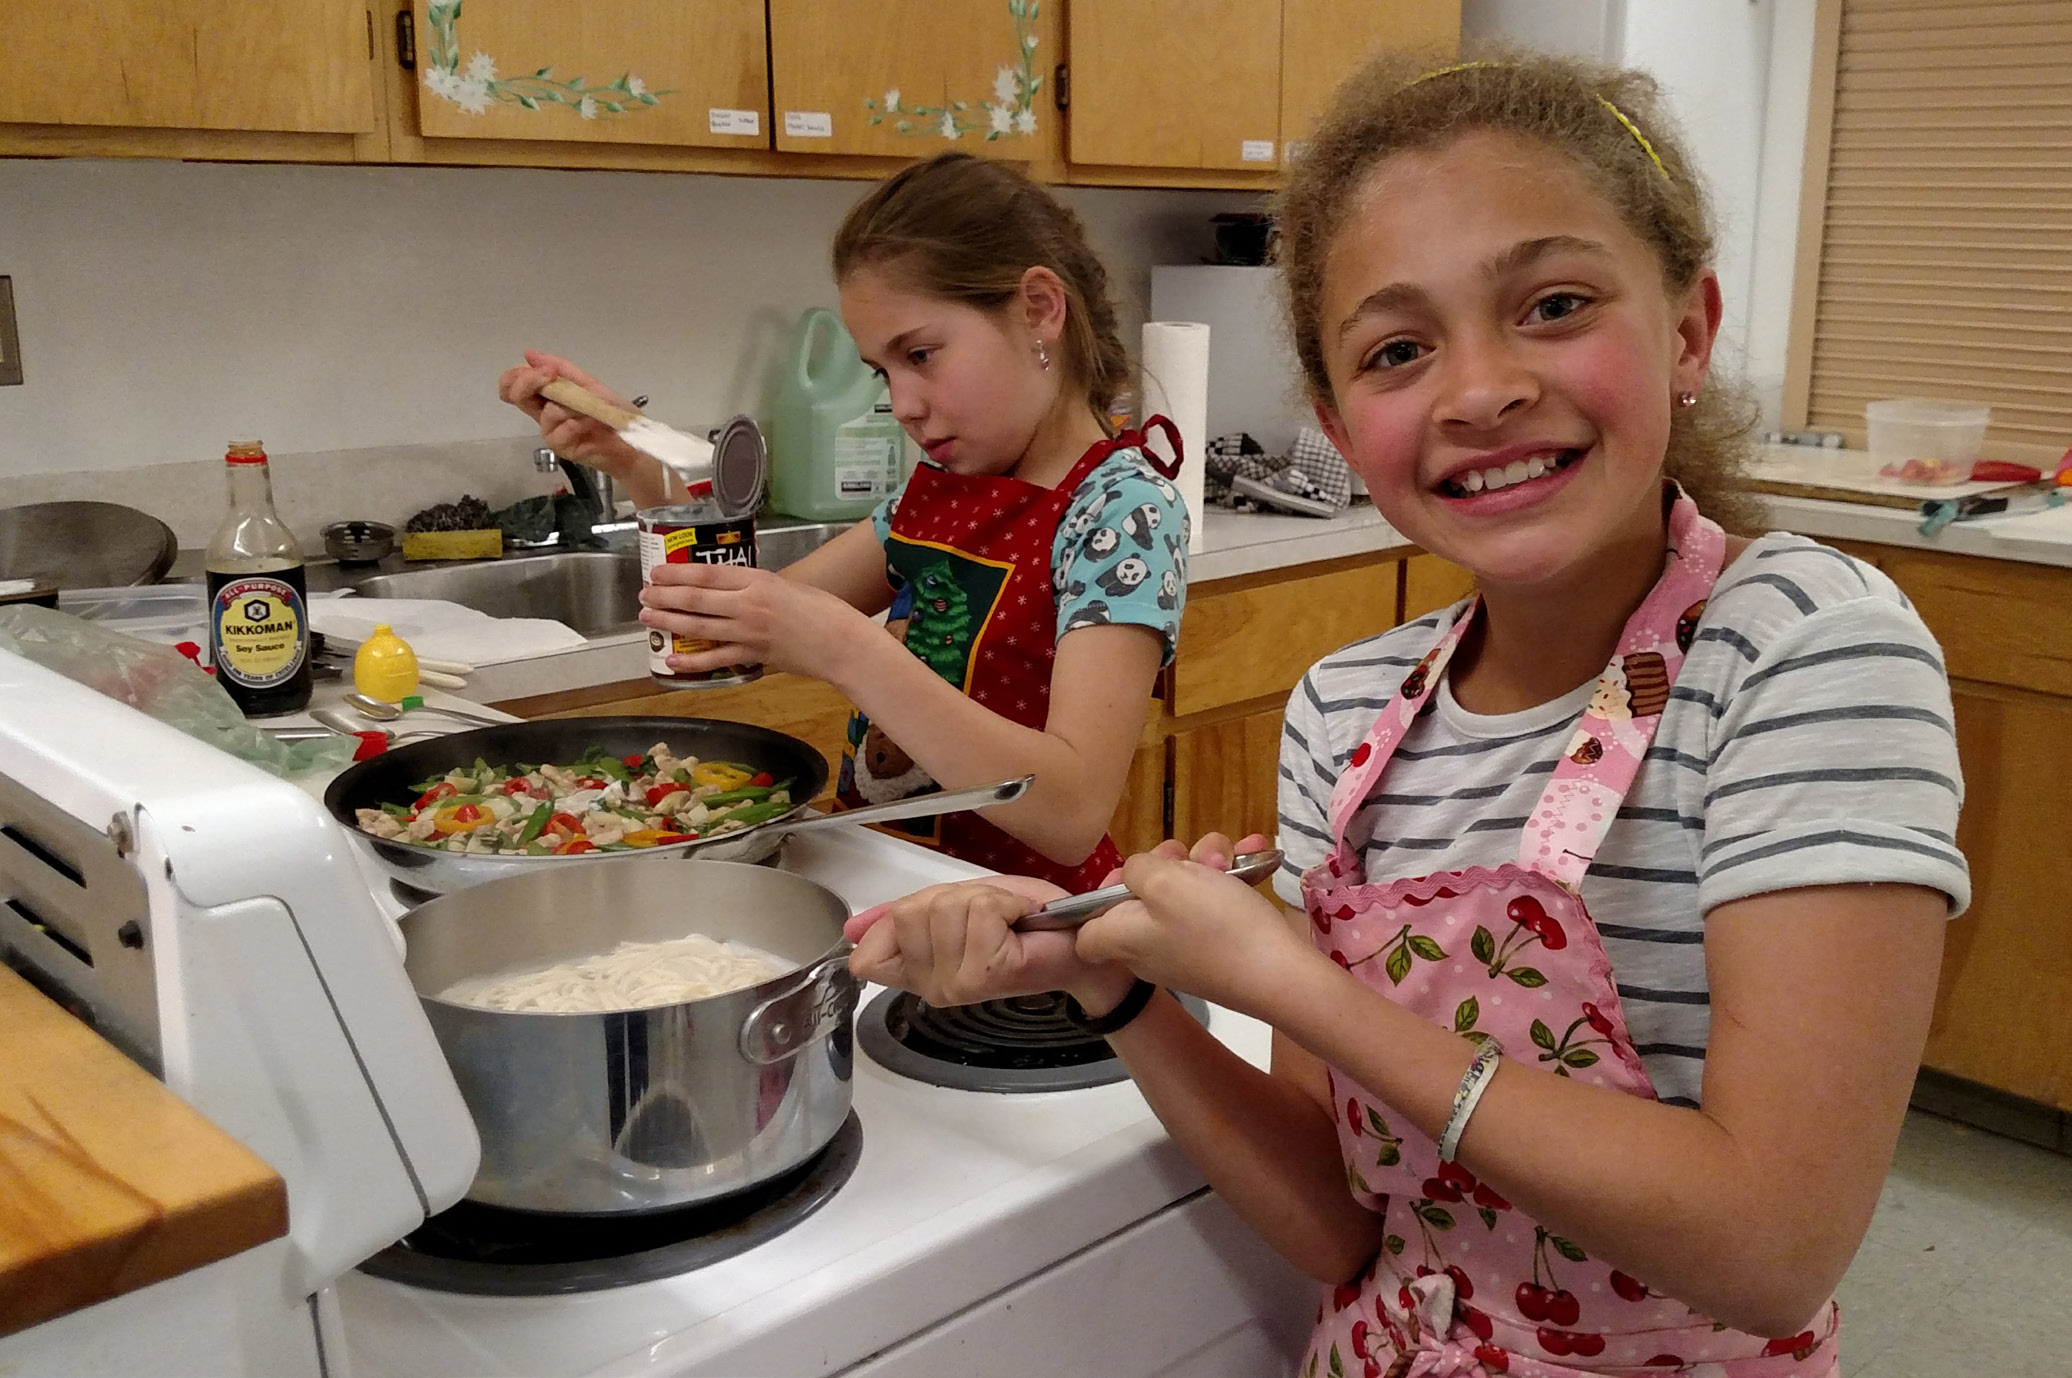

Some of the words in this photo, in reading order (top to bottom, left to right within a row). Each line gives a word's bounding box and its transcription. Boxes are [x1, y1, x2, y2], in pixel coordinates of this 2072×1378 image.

[678, 531, 693, 540] LOOK
[695, 545, 752, 568] THAI
[225, 621, 293, 636] KIKKOMAN
[235, 645, 253, 654] Soy
[255, 642, 285, 652] Sauce
